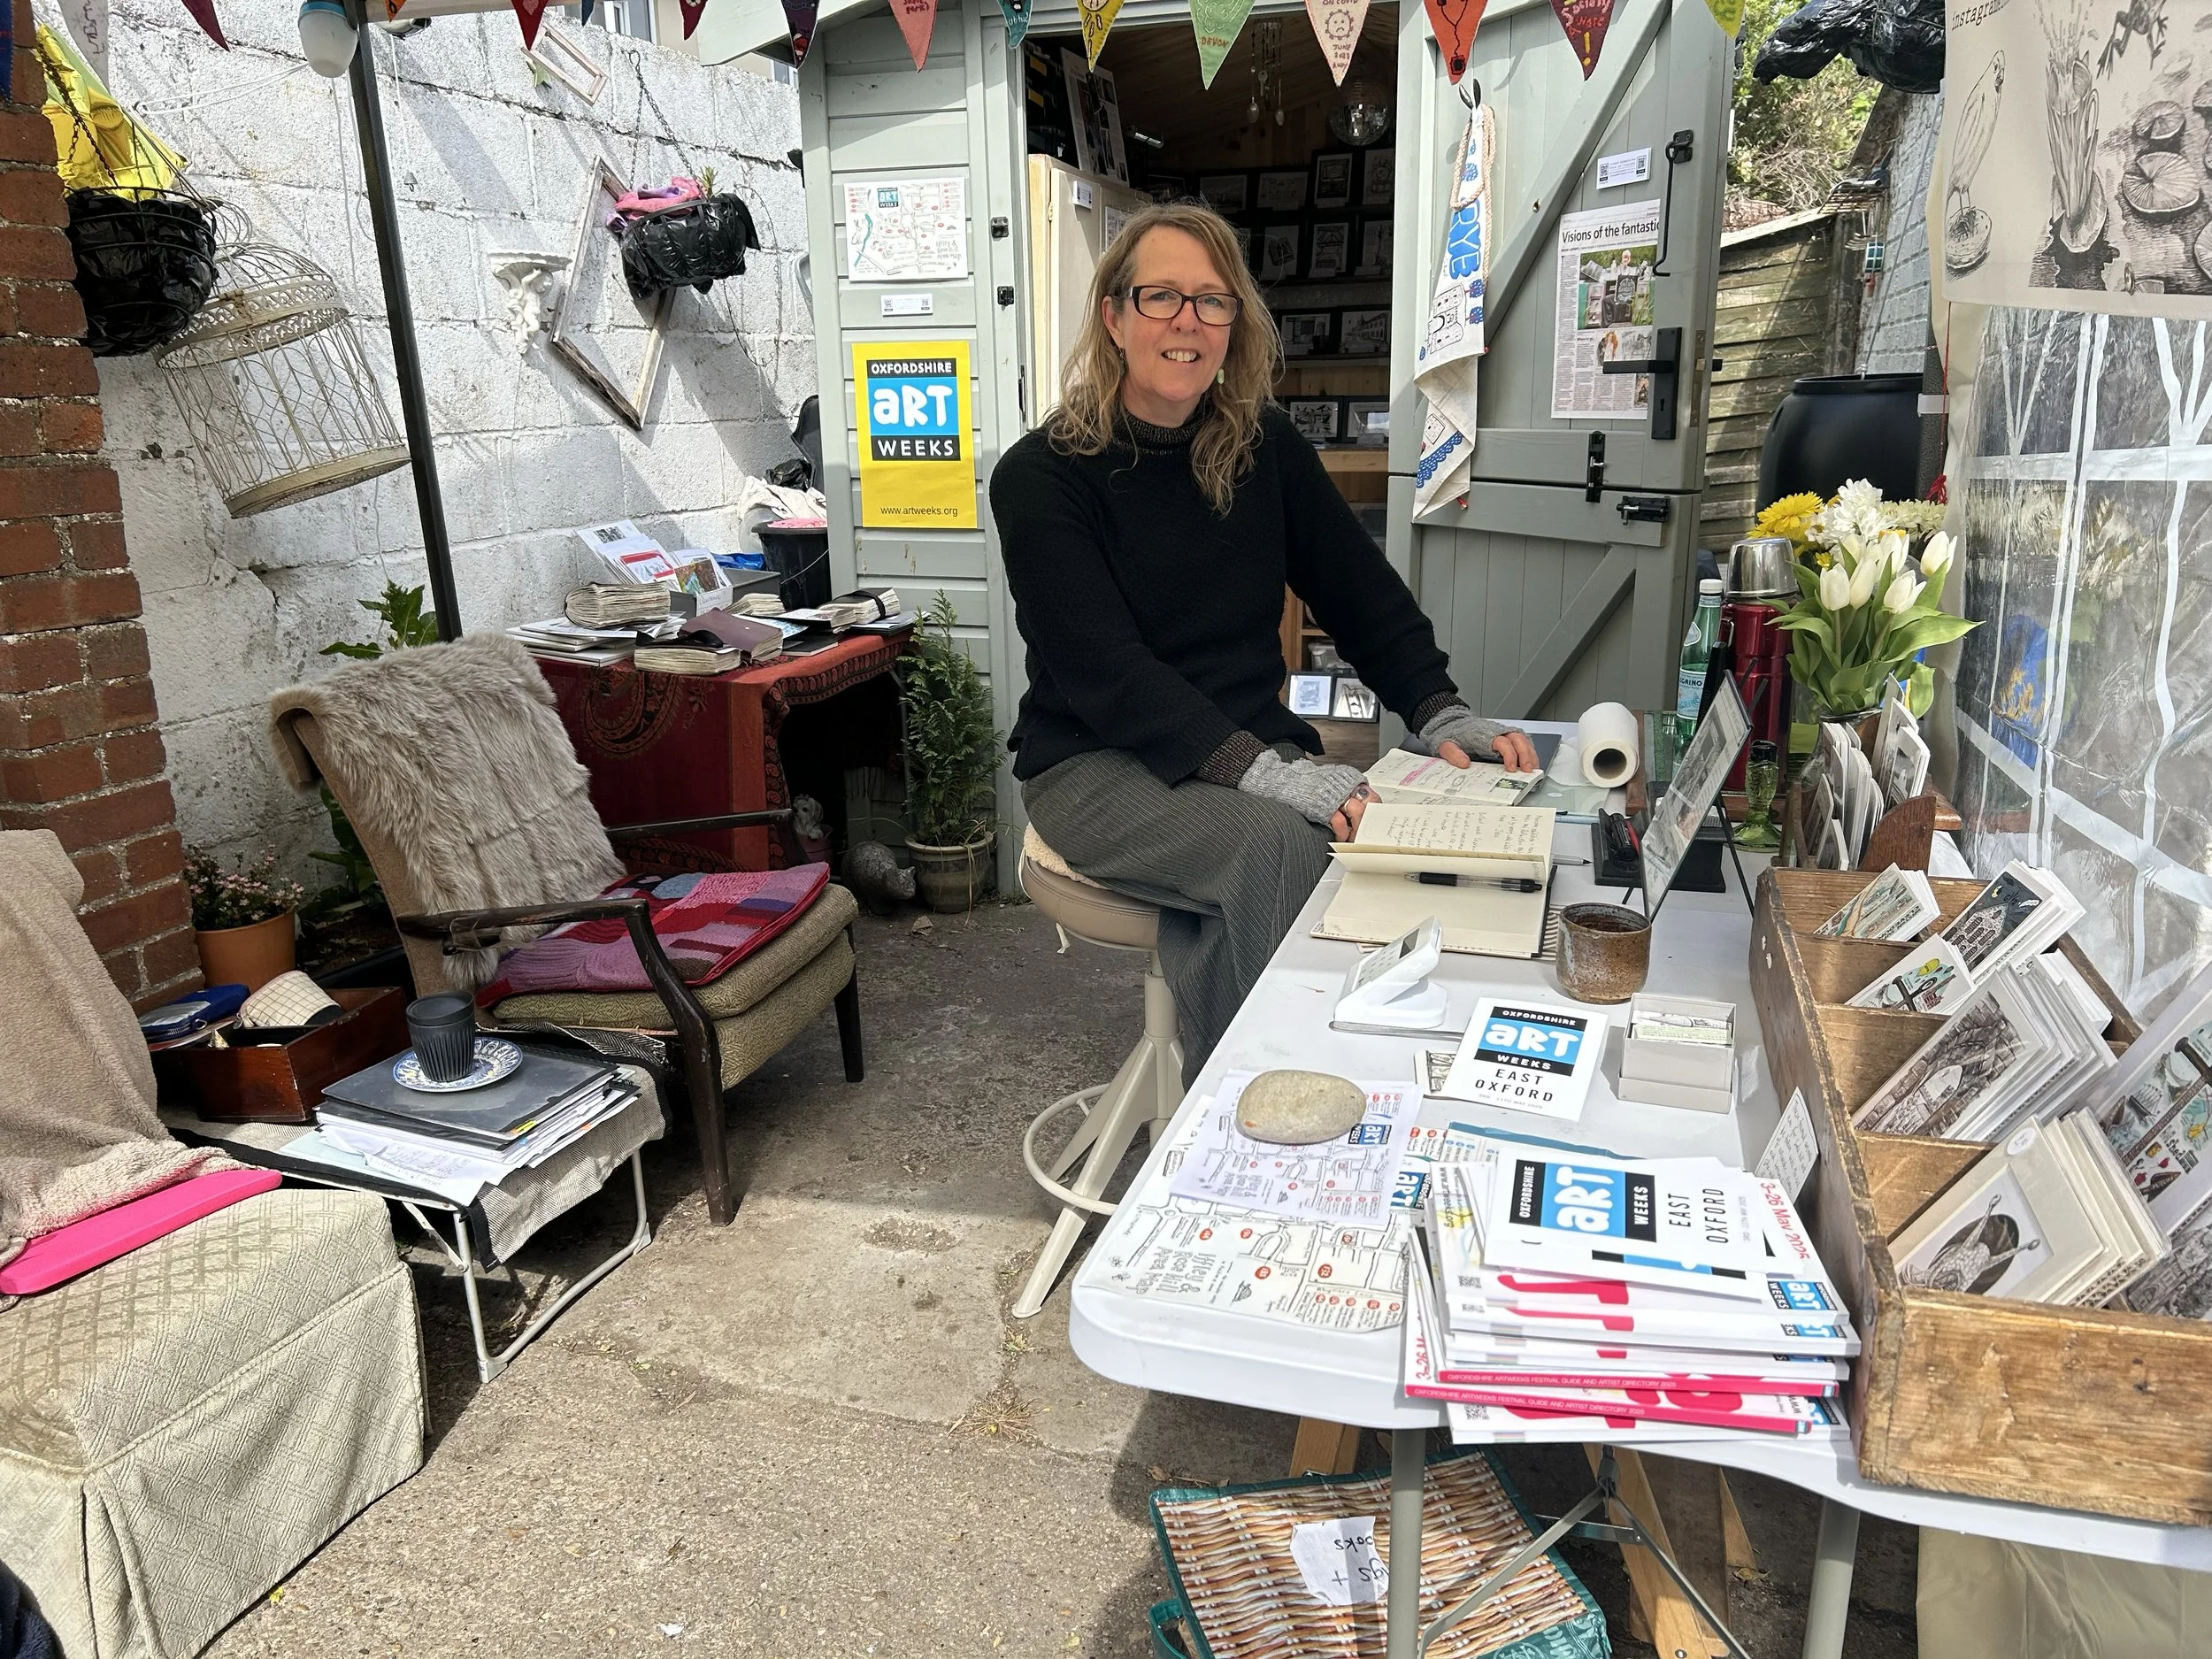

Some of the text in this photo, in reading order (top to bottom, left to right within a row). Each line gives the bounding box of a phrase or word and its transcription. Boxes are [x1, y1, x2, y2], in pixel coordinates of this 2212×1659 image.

[1200, 36, 1230, 48] DEVON
[1563, 229, 1592, 243] Visions
[1594, 226, 1603, 239] of
[1605, 225, 1620, 237] the
[871, 362, 952, 375] OXFORDSHIRE
[878, 439, 955, 457] WEEKS
[880, 506, 958, 517] www.artweeks.org
[1502, 1010, 1576, 1026] OXFORDSHIRE
[1496, 1054, 1552, 1071] WEEKS
[1495, 1068, 1544, 1085] EAST
[1475, 1079, 1554, 1102] OXFORD
[1519, 1165, 1535, 1218] OXFORDSHIRE
[1633, 1186, 1649, 1225] WEEKS
[1668, 1194, 1692, 1227] EAST
[1702, 1188, 1730, 1244] OXFORD
[1769, 1282, 1789, 1310] WEEKS
[1414, 1389, 1460, 1398] OXFORDSHIRE
[1461, 1393, 1497, 1402] ARTWEEKS
[1498, 1395, 1526, 1404] FESTIVAL
[1528, 1398, 1548, 1407] GUIDE
[1566, 1402, 1588, 1410] ARTIST
[1589, 1404, 1627, 1413] DIRECTORY
